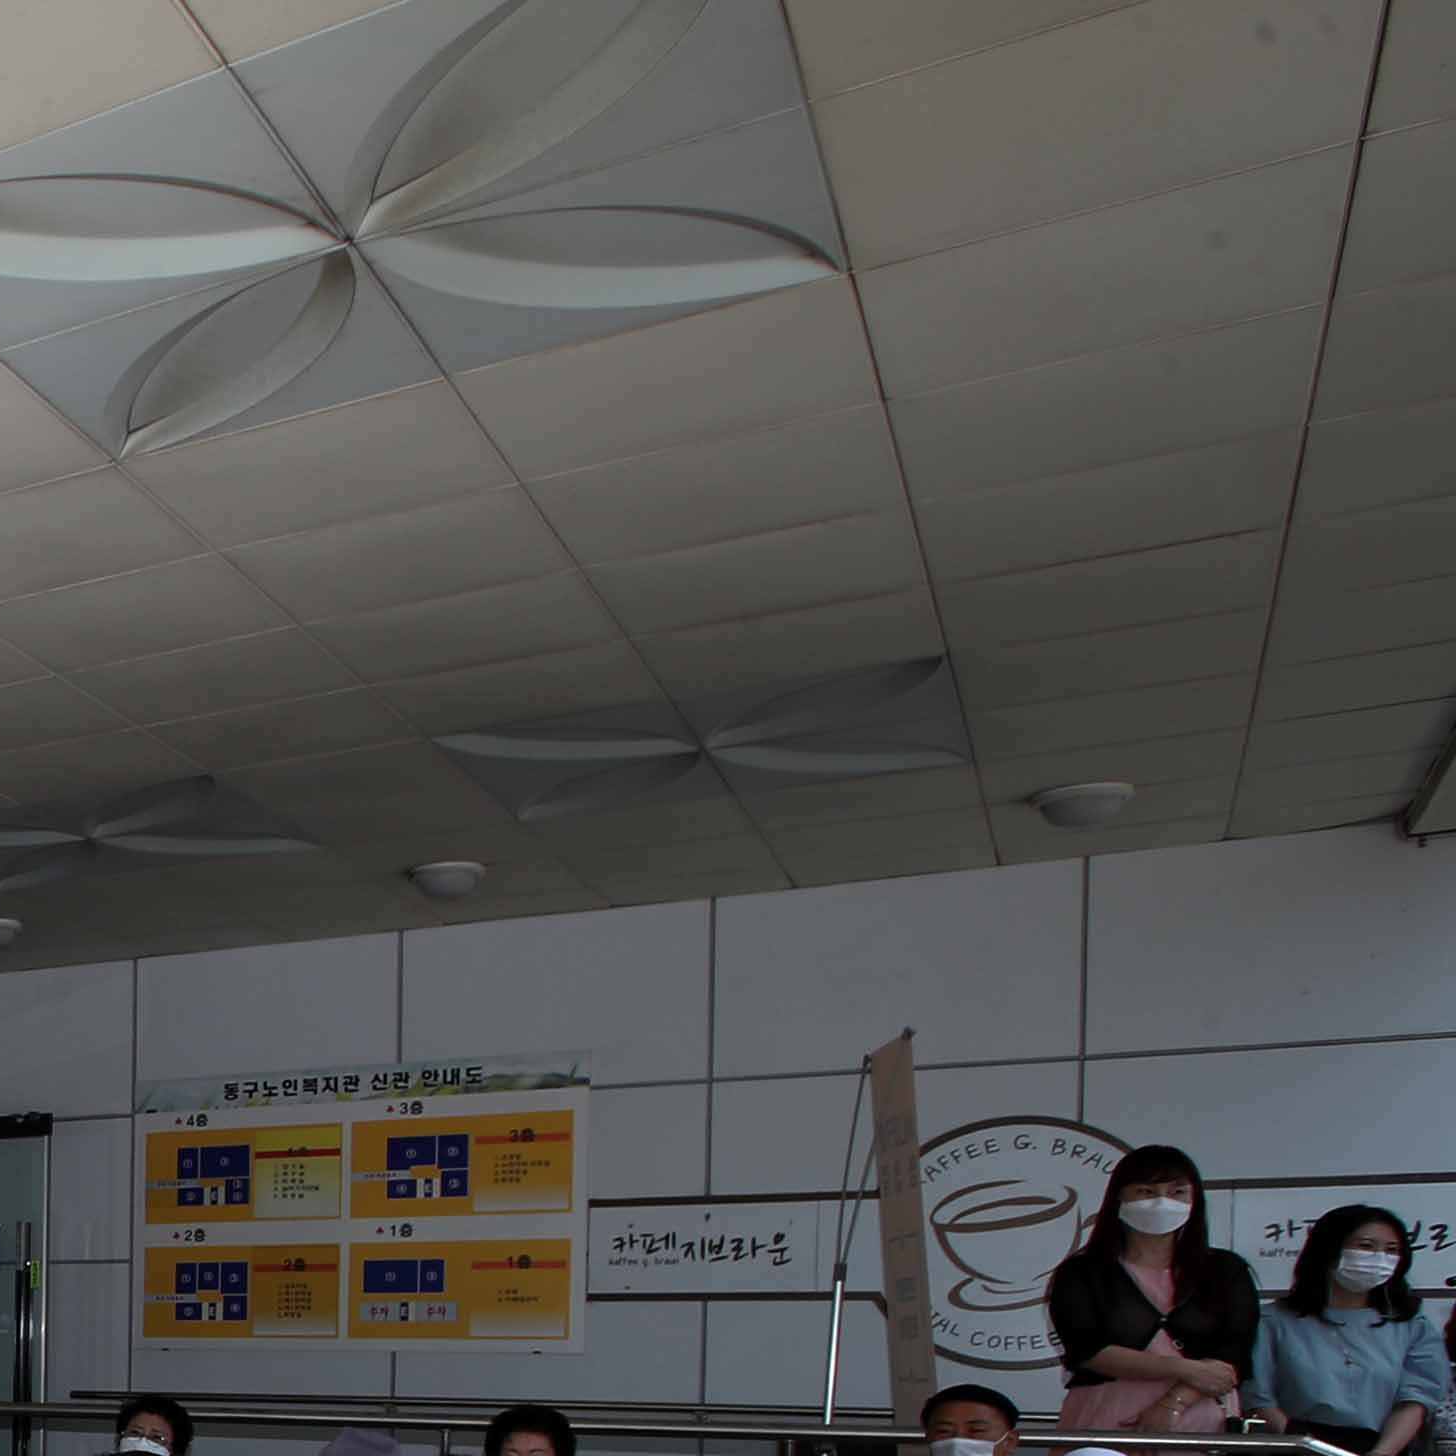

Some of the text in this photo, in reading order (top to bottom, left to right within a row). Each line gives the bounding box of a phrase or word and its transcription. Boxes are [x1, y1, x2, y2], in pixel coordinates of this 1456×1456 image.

[224, 1066, 483, 1101] 동구노인복지관 신관 안내도
[1014, 1133, 1038, 1151] G.
[612, 1231, 793, 1266] 카페 지브라운
